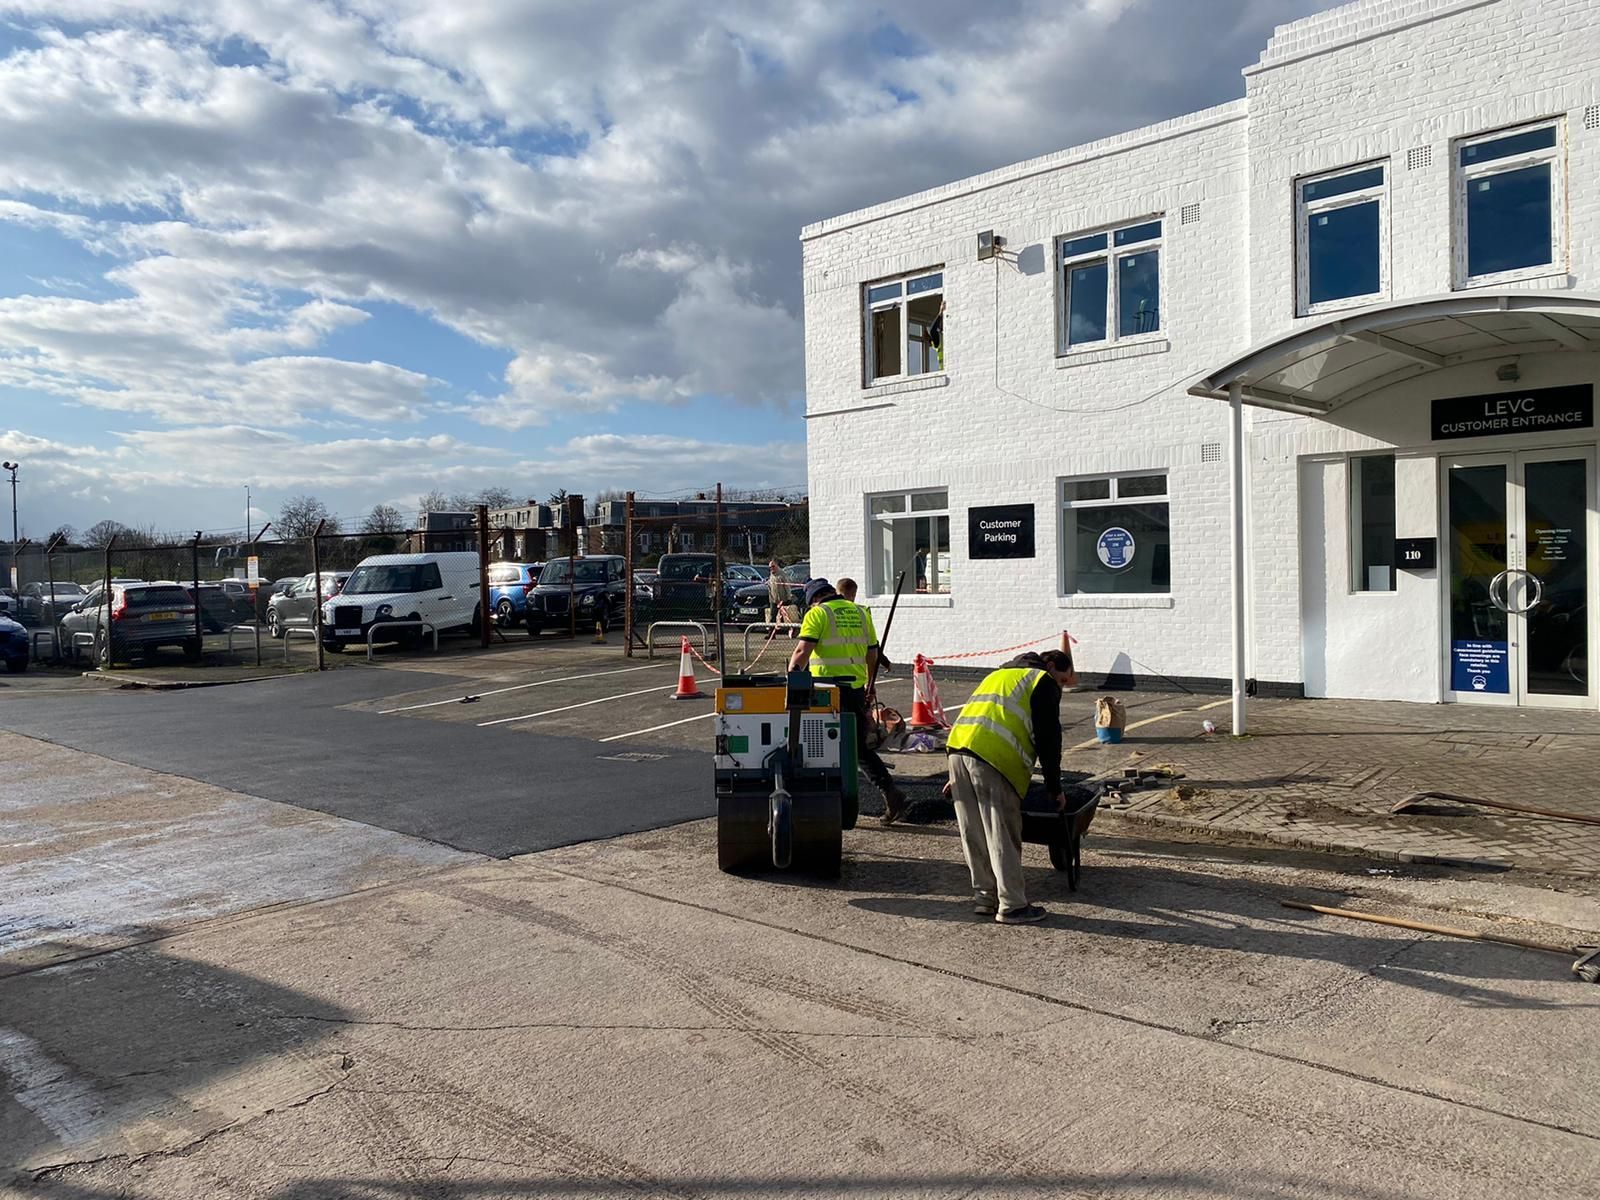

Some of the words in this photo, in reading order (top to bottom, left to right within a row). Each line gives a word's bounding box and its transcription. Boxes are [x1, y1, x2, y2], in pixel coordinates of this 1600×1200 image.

[1484, 398, 1536, 416] LEVC
[1440, 418, 1509, 434] CUSTOMER
[1511, 411, 1584, 428] ENTRANCE
[979, 520, 1021, 529] Customer
[984, 532, 1017, 544] Parking
[1404, 550, 1421, 560] 110
